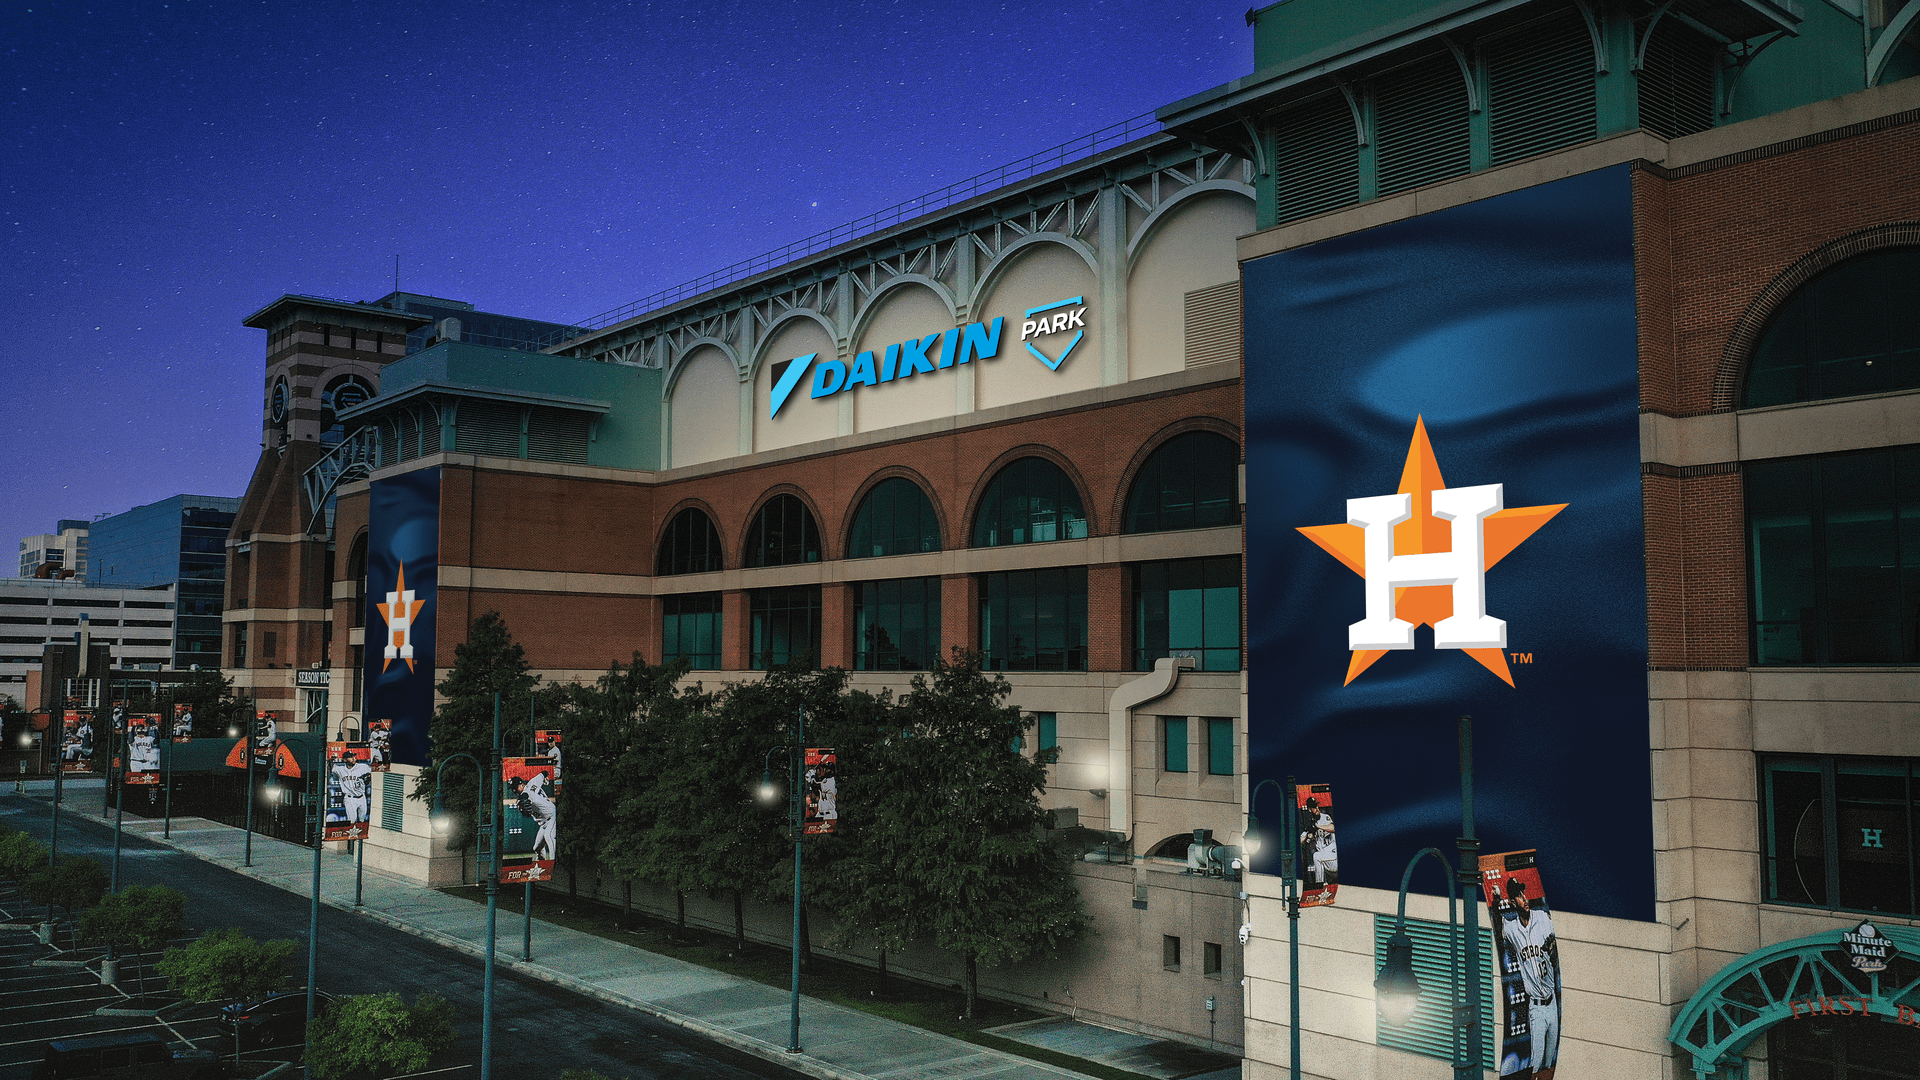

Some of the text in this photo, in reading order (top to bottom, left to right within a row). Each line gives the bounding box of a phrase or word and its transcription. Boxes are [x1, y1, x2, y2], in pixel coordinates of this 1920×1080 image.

[1020, 307, 1088, 341] PARK
[810, 316, 1004, 399] DAIKIN
[1347, 483, 1507, 650] H
[384, 589, 415, 659] H
[1511, 652, 1533, 664] TM
[1861, 828, 1884, 848] H
[1843, 932, 1892, 947] Minute
[1850, 943, 1887, 957] Maid
[1851, 956, 1887, 972] Park
[1788, 996, 1874, 1020] FIRST
